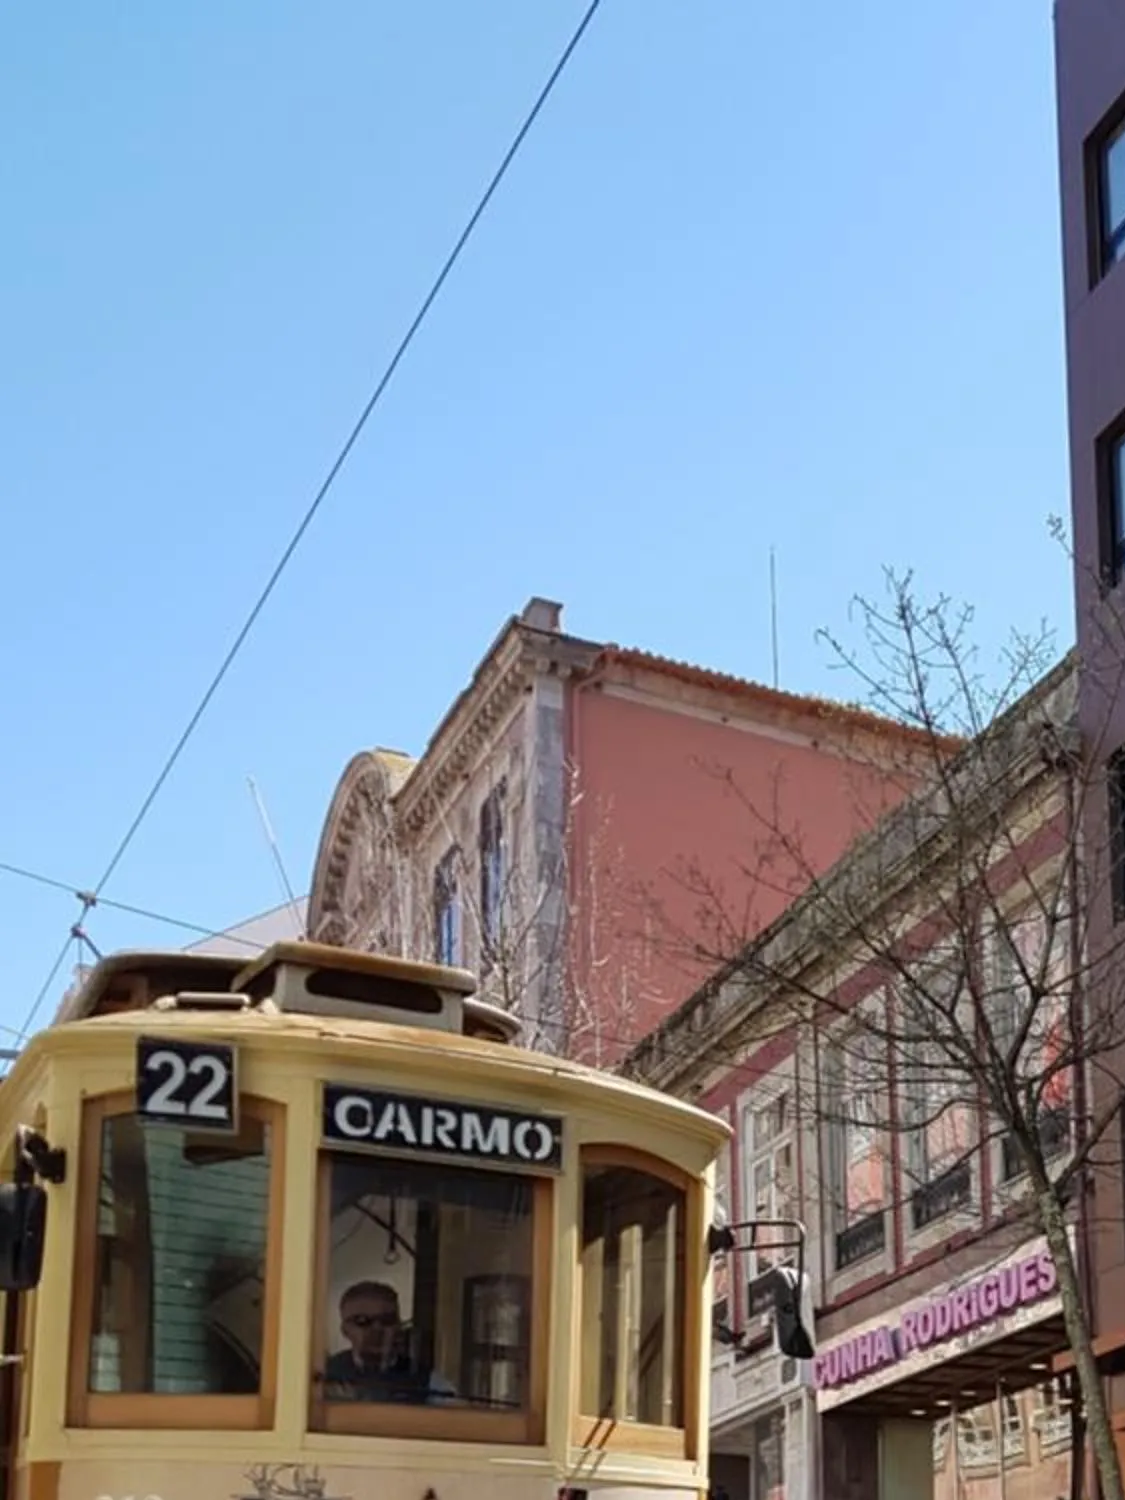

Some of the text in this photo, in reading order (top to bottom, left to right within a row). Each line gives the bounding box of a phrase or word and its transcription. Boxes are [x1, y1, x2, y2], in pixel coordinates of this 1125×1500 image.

[143, 1049, 229, 1120] 22
[333, 1094, 556, 1161] CARMO
[811, 1250, 1057, 1390] CUNHA RODRIGUES
